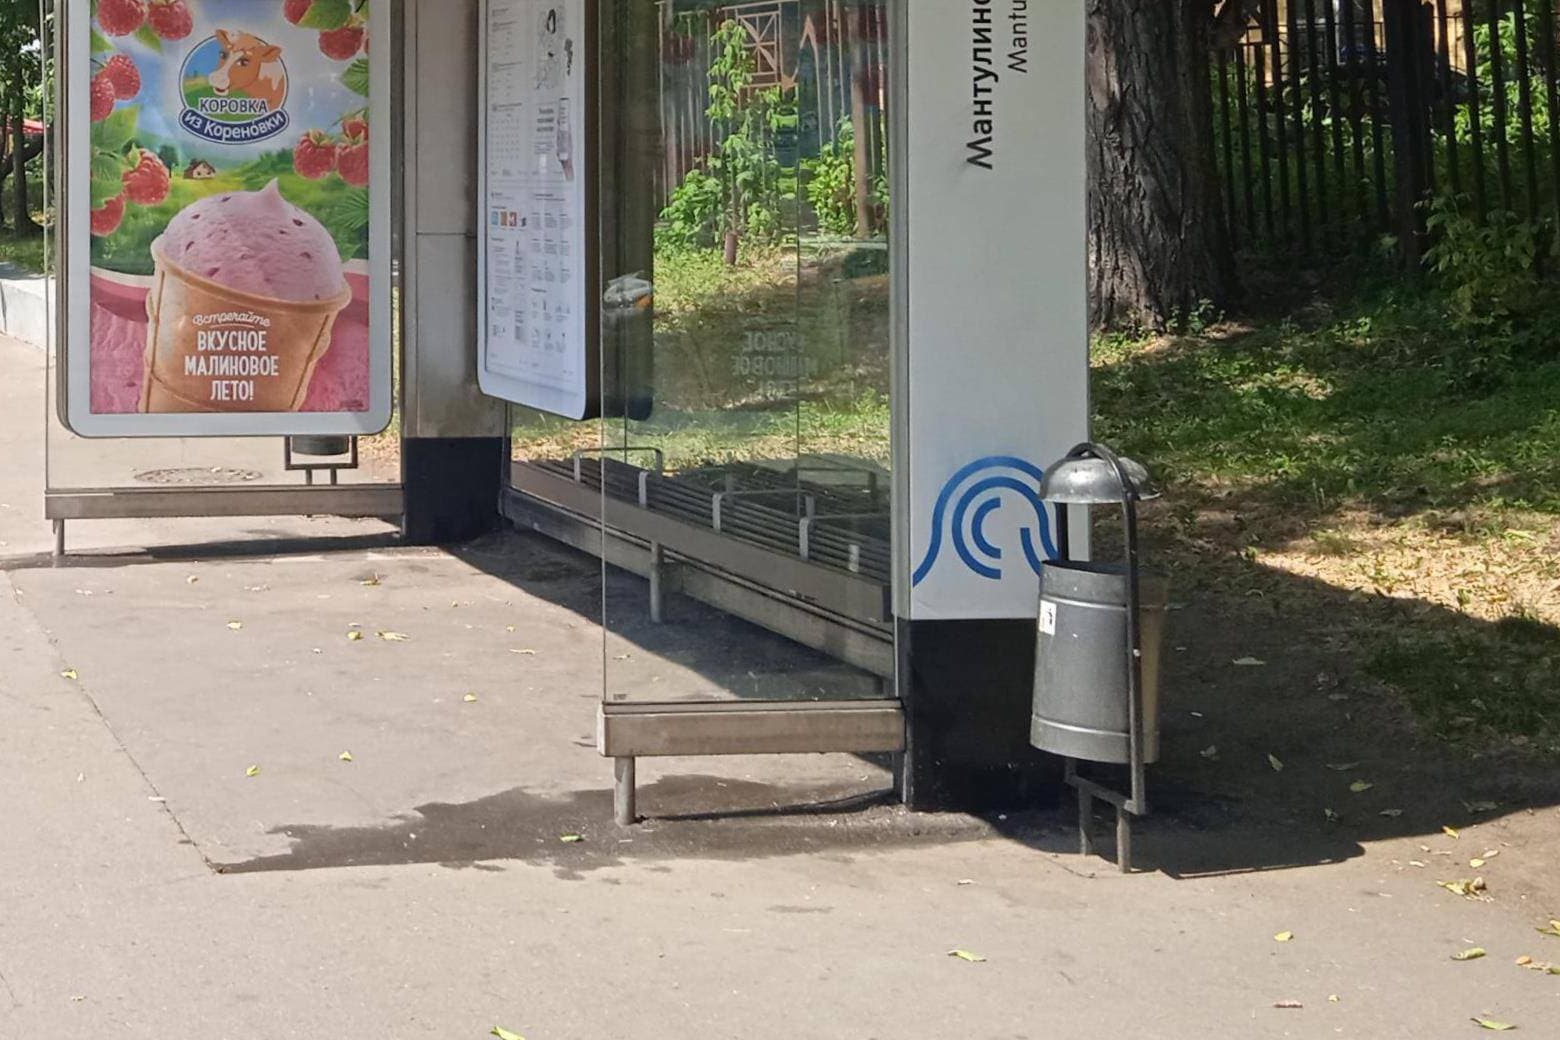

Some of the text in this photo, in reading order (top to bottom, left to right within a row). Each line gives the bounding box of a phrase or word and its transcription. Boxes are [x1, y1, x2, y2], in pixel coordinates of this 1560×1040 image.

[199, 98, 268, 113] КОРОВКА
[197, 330, 267, 351] ВКУСНОЕ
[184, 355, 280, 376] МАЛИНОВОЕ
[210, 380, 254, 401] ЛЕТО!
